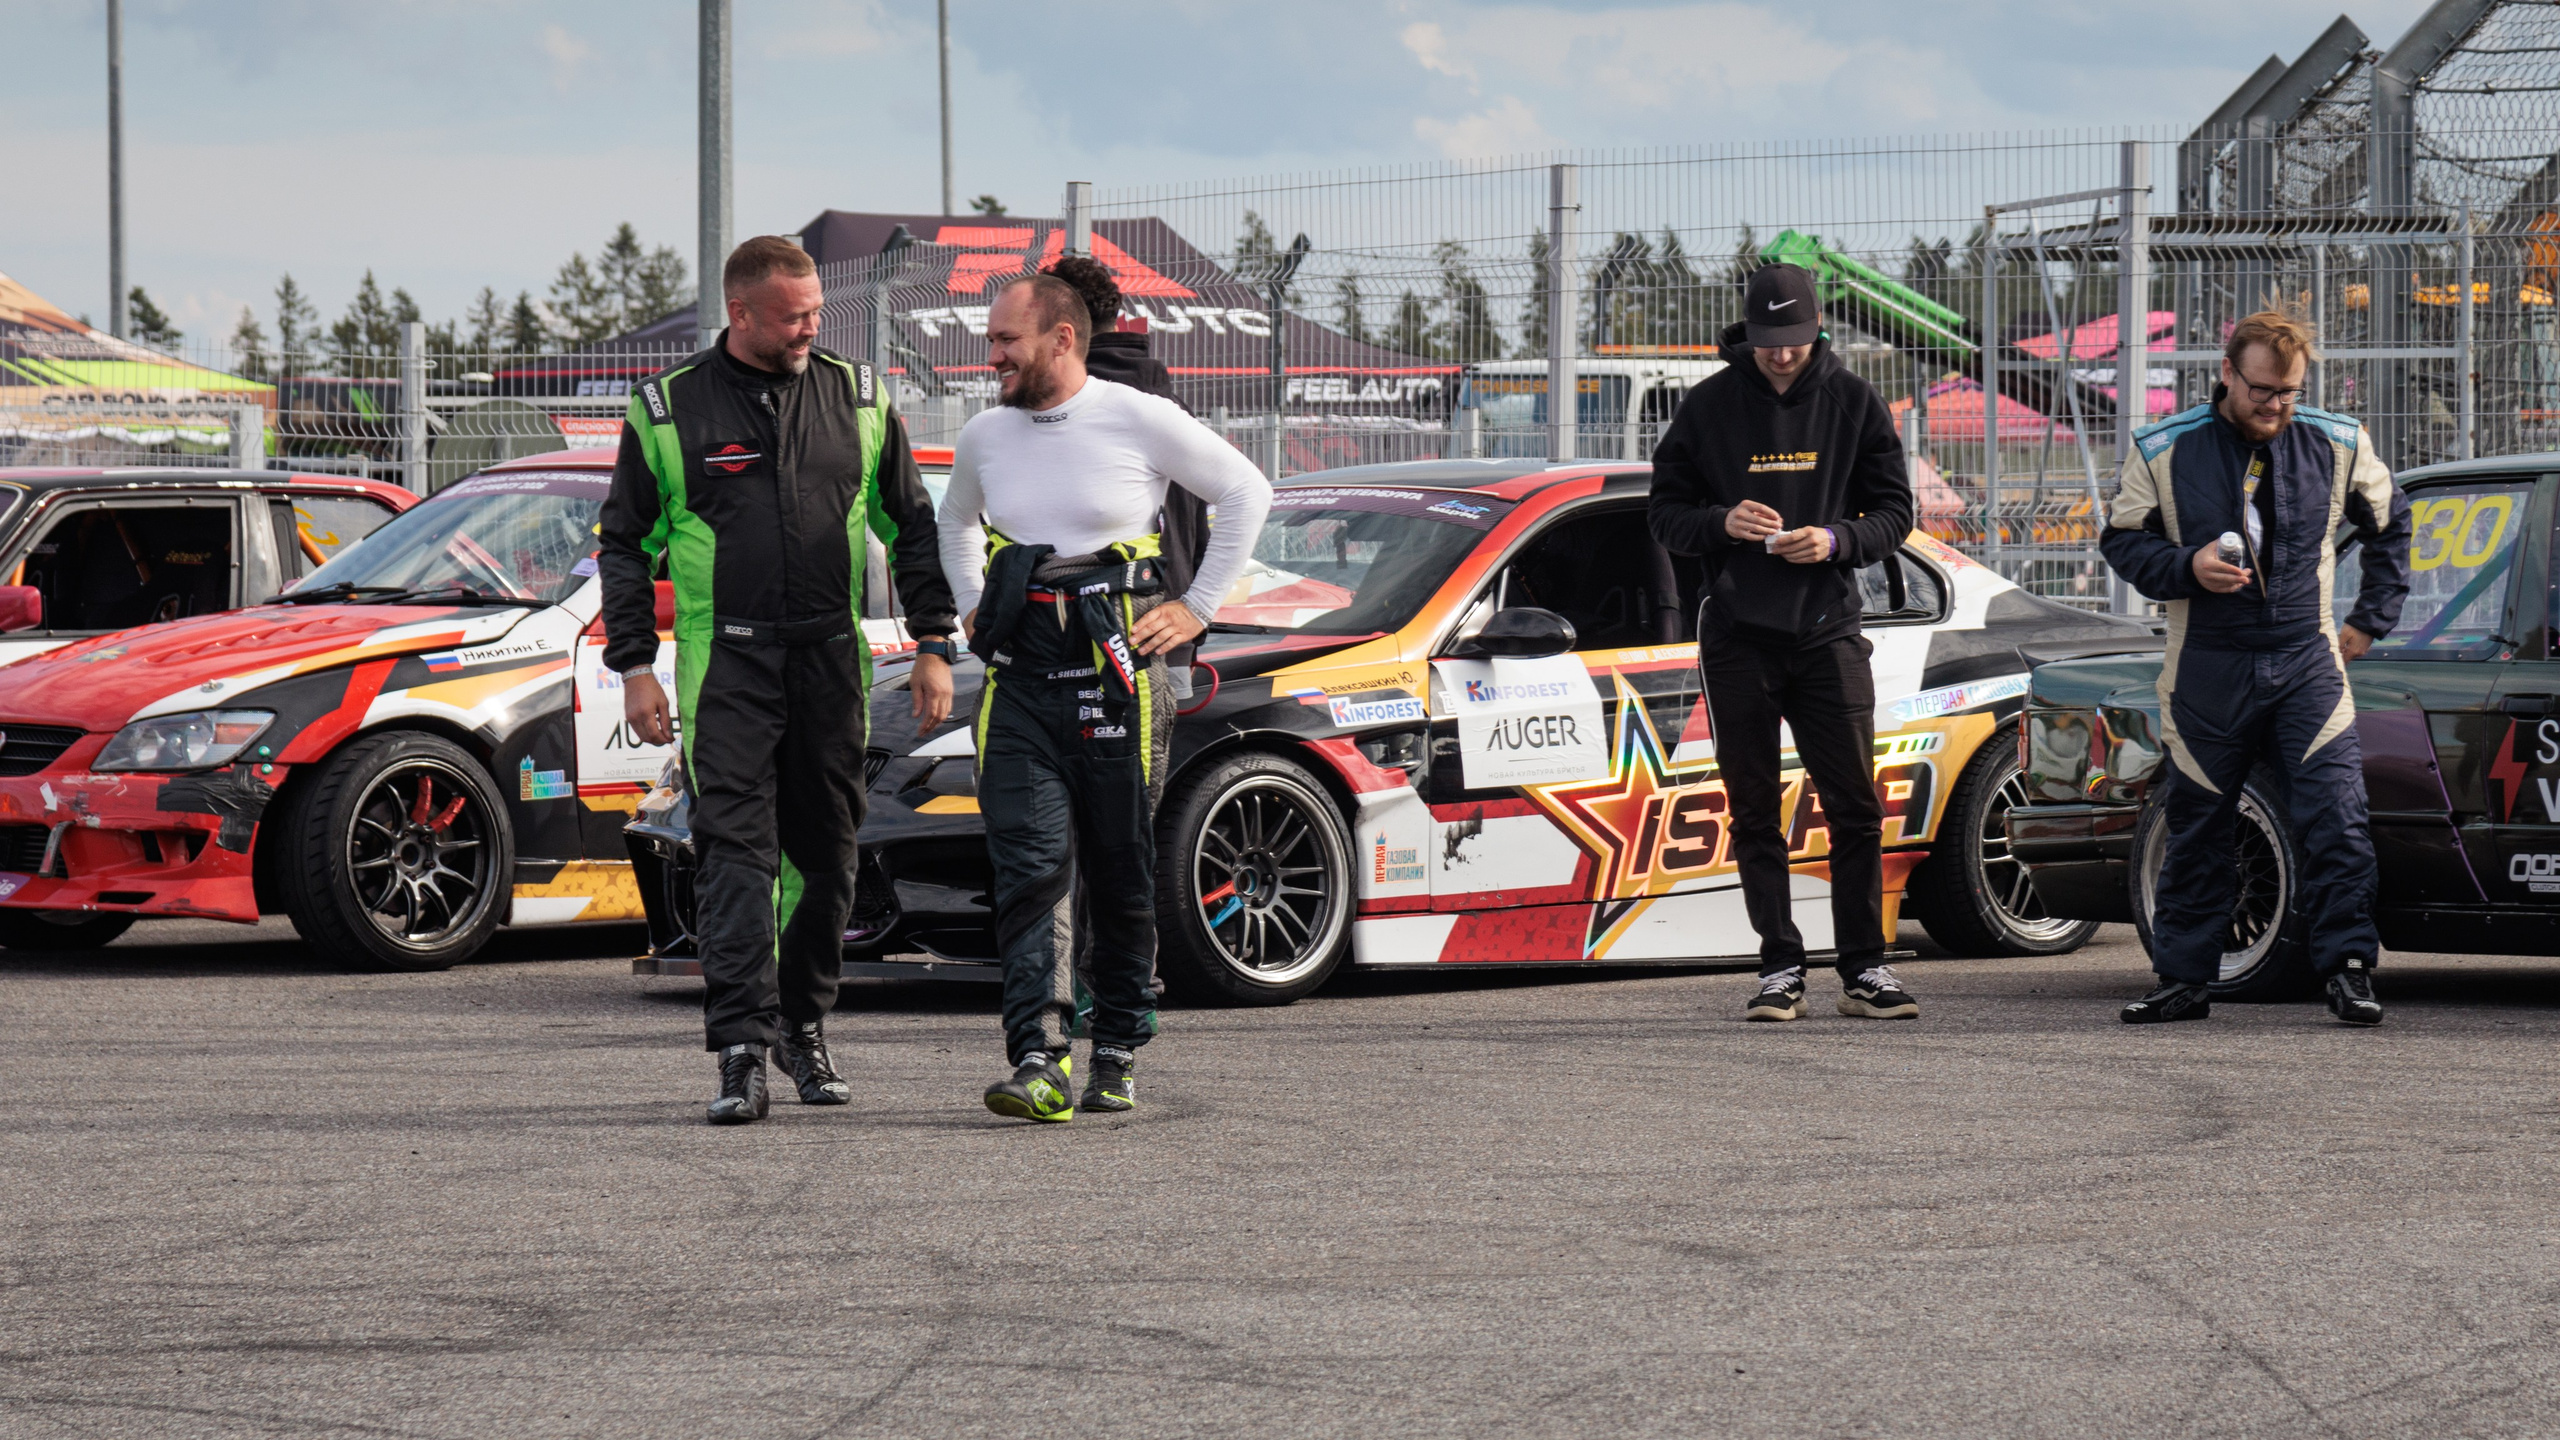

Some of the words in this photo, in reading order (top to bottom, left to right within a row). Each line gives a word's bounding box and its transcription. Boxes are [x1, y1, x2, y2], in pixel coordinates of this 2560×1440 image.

[1321, 676, 1398, 693] Алексашкин
[1465, 680, 1568, 702] KINFOREST
[1332, 700, 1421, 723] KINFOREST
[1915, 689, 1966, 715] ПЕРВАЯ
[1486, 715, 1582, 751] AUGER
[533, 771, 563, 783] ГАЗОВАЯ
[1517, 769, 1554, 777] КУЛЬТУРА
[521, 770, 532, 798] ПЕРВАЯ
[533, 784, 572, 797] КОМПАНИЯ
[1376, 845, 1386, 882] ПЕРВАЯ
[1387, 849, 1416, 864] ГАЗОВАЯ
[1387, 866, 1424, 881] КОМПАНИЯ
